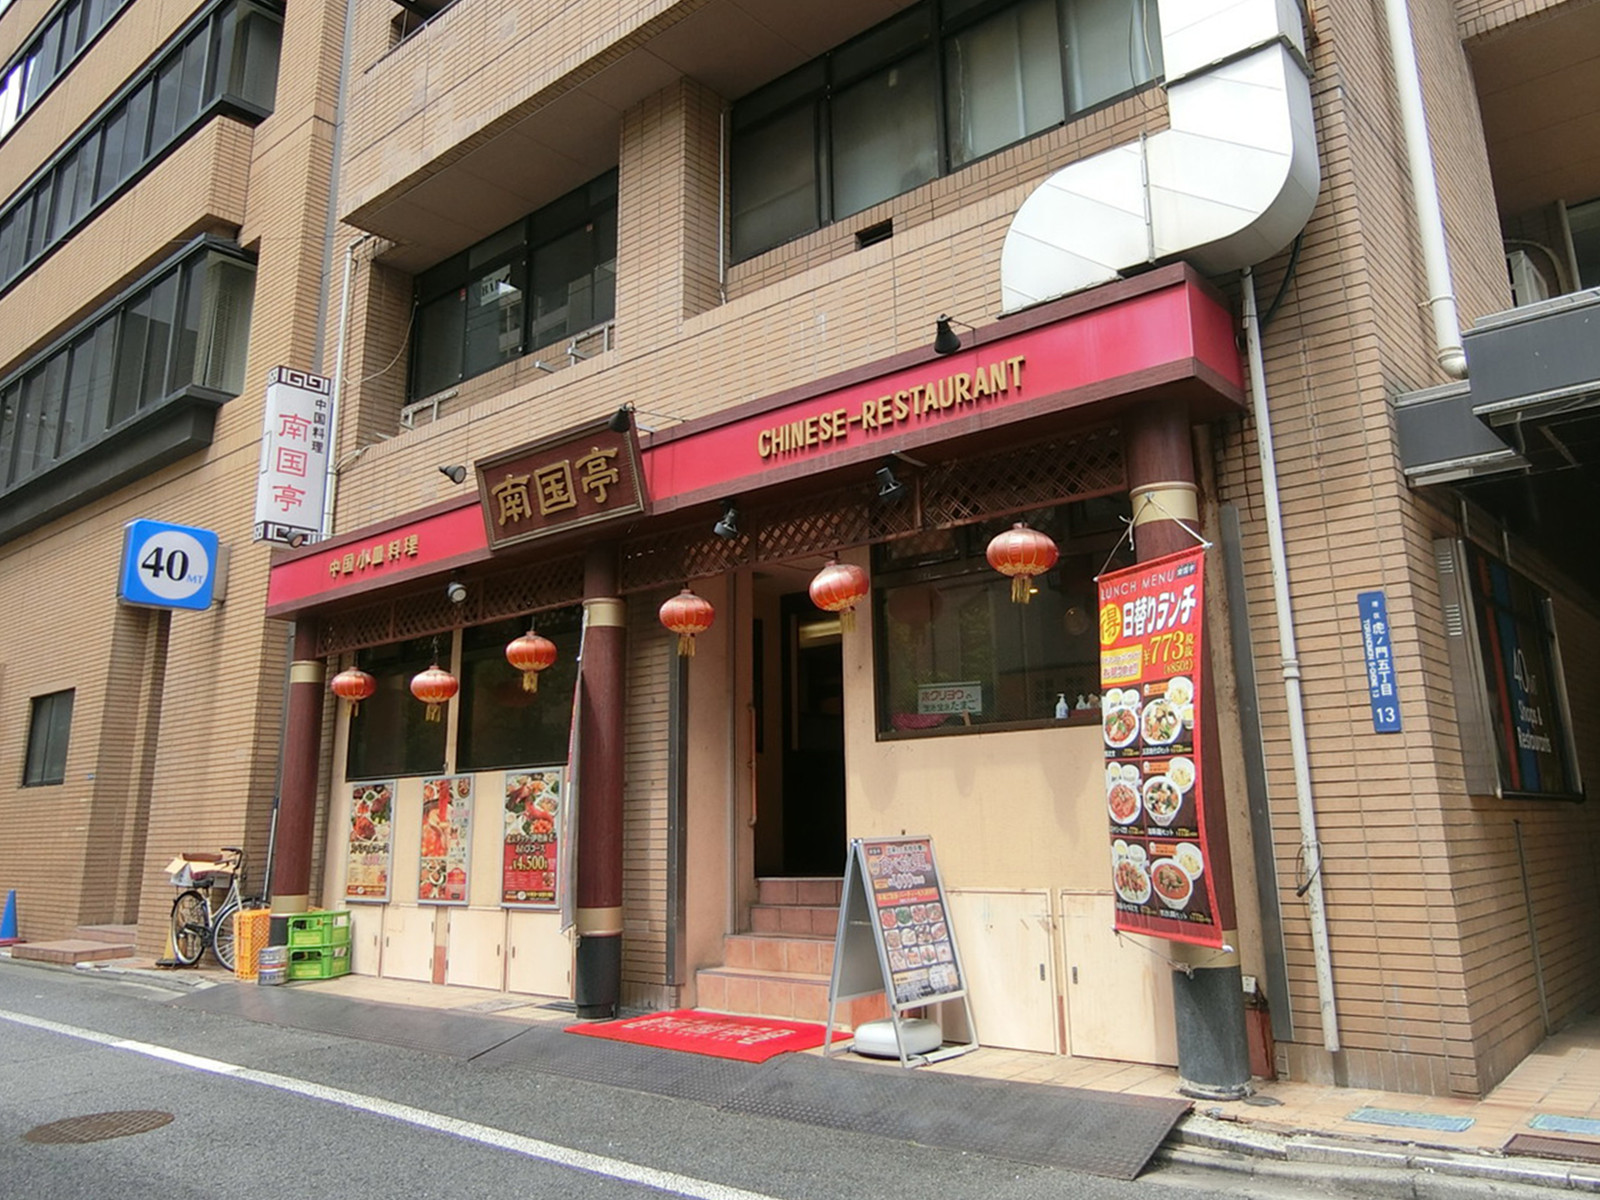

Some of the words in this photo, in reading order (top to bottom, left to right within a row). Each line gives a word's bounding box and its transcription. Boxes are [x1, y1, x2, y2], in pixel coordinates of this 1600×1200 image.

[311, 399, 327, 454] 中国料理
[757, 355, 1026, 458] CHINESE-RESTAURANT
[271, 413, 312, 512] 南国亭
[491, 446, 619, 526] 南国亭
[141, 547, 189, 581] 40
[329, 534, 420, 578] 中国小皿料理
[1100, 581, 1137, 600] LUNCH
[1141, 570, 1175, 589] MENU
[1100, 606, 1120, 639] 得
[1122, 584, 1197, 638] 日替りランチ
[1376, 706, 1396, 724] 13
